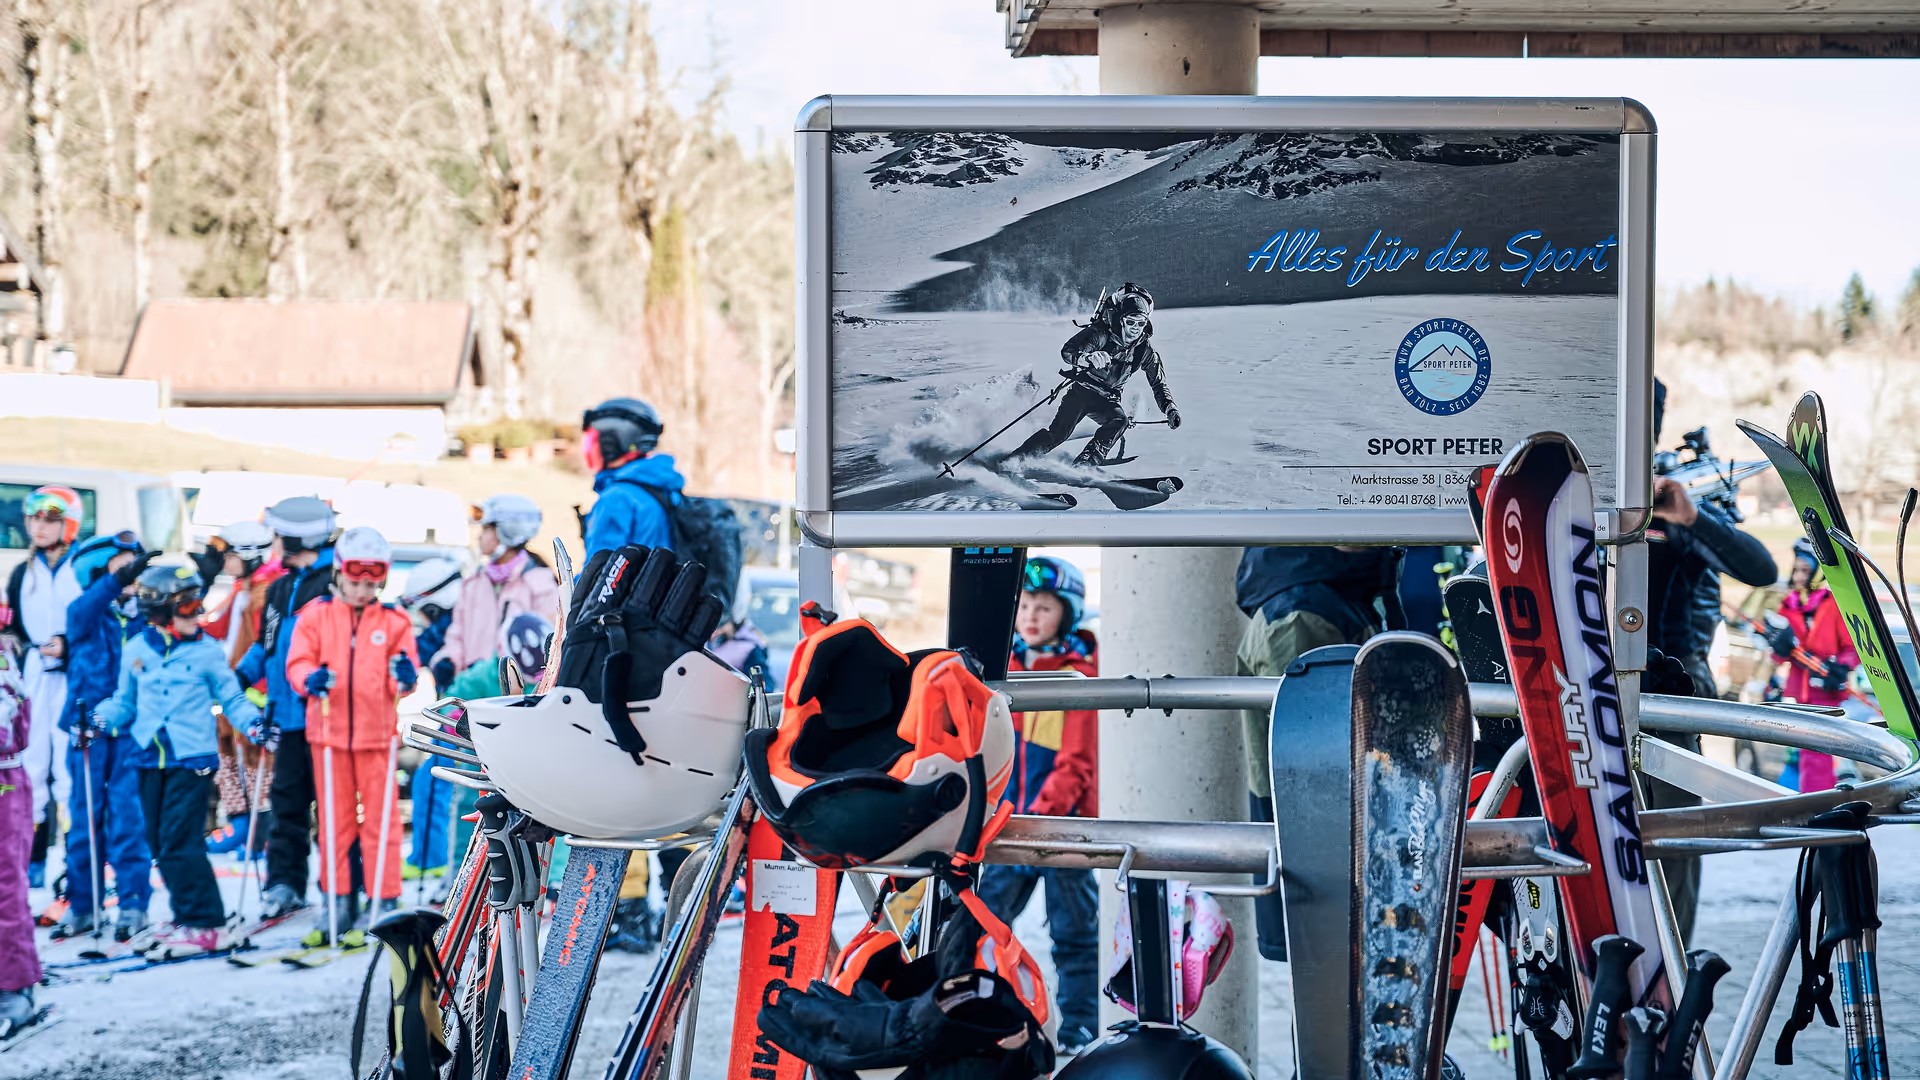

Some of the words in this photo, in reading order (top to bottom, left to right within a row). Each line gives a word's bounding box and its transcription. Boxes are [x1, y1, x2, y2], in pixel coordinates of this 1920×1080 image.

[1246, 228, 1347, 272] Alles
[1346, 228, 1419, 287] für
[1425, 228, 1491, 272] den
[1500, 230, 1617, 288] Sport
[1398, 320, 1488, 364] WWW.SPORT-PETER.DE
[1423, 360, 1446, 369] SPORT
[1450, 360, 1472, 369] PETER
[1399, 377, 1414, 397] BAD
[1449, 396, 1471, 412] SEIT
[1471, 373, 1488, 397] 1982
[1367, 438, 1437, 455] SPORT
[1443, 438, 1503, 455] PETER
[1337, 494, 1358, 505] Tel.:
[1368, 494, 1382, 505] 49
[1351, 474, 1418, 485] Marktstrasse
[1422, 474, 1435, 485] 38
[1552, 661, 1599, 789] FURY
[1570, 522, 1649, 887] SALOMON
[558, 863, 597, 967] ATOMIC
[1592, 1002, 1611, 1055] LEKI
[1681, 1019, 1701, 1071] LEKI
